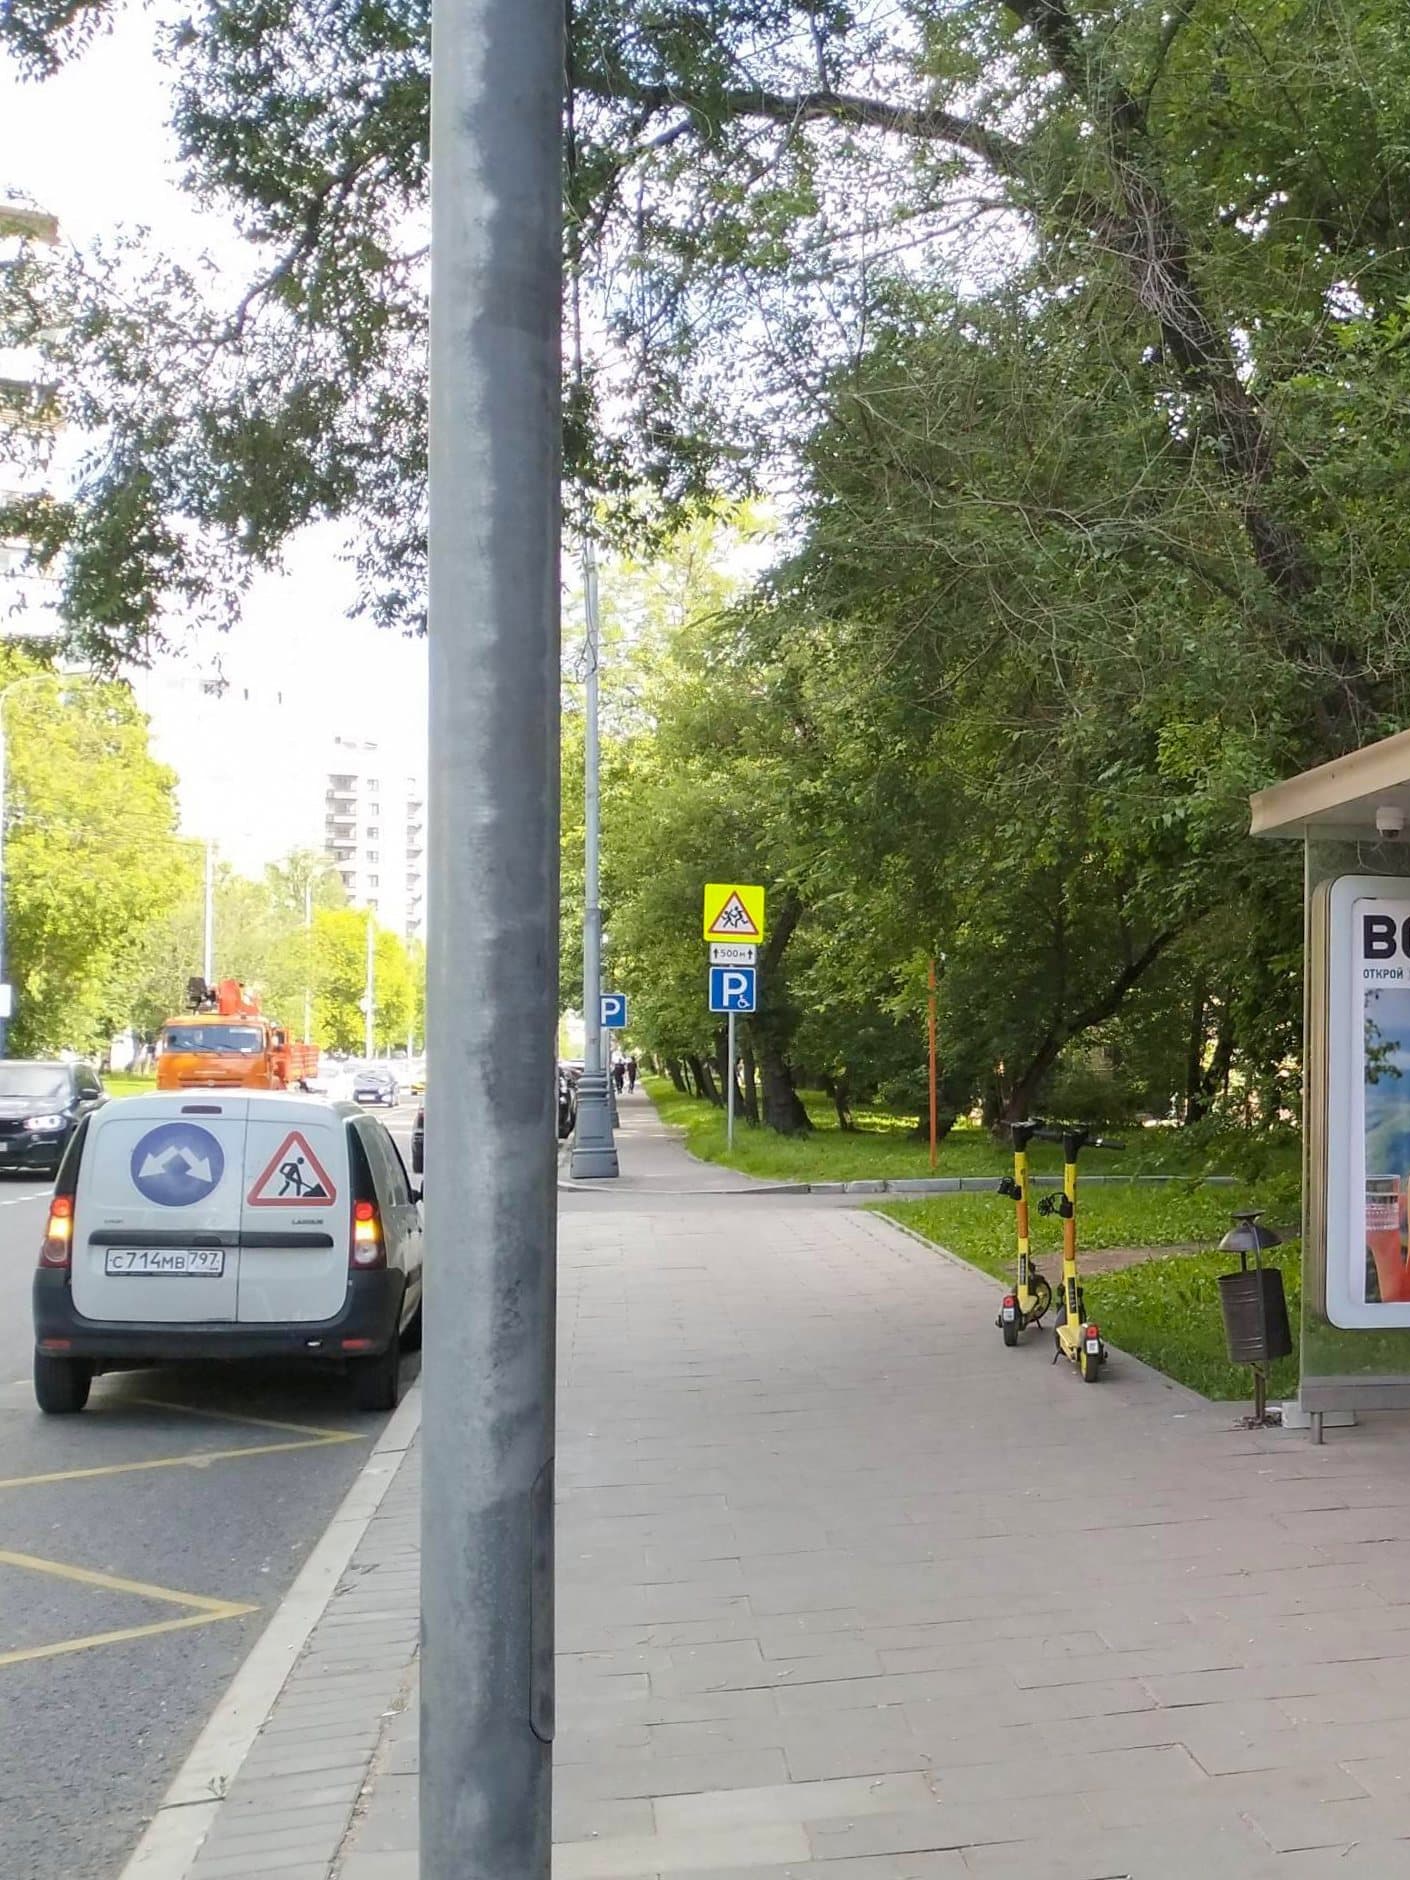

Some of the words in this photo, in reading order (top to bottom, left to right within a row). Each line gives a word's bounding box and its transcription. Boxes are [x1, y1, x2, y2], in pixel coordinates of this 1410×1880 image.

[1363, 966, 1404, 980] ОТКРОЙ
[722, 972, 748, 1007] P
[600, 998, 621, 1025] P
[189, 1252, 218, 1265] 797
